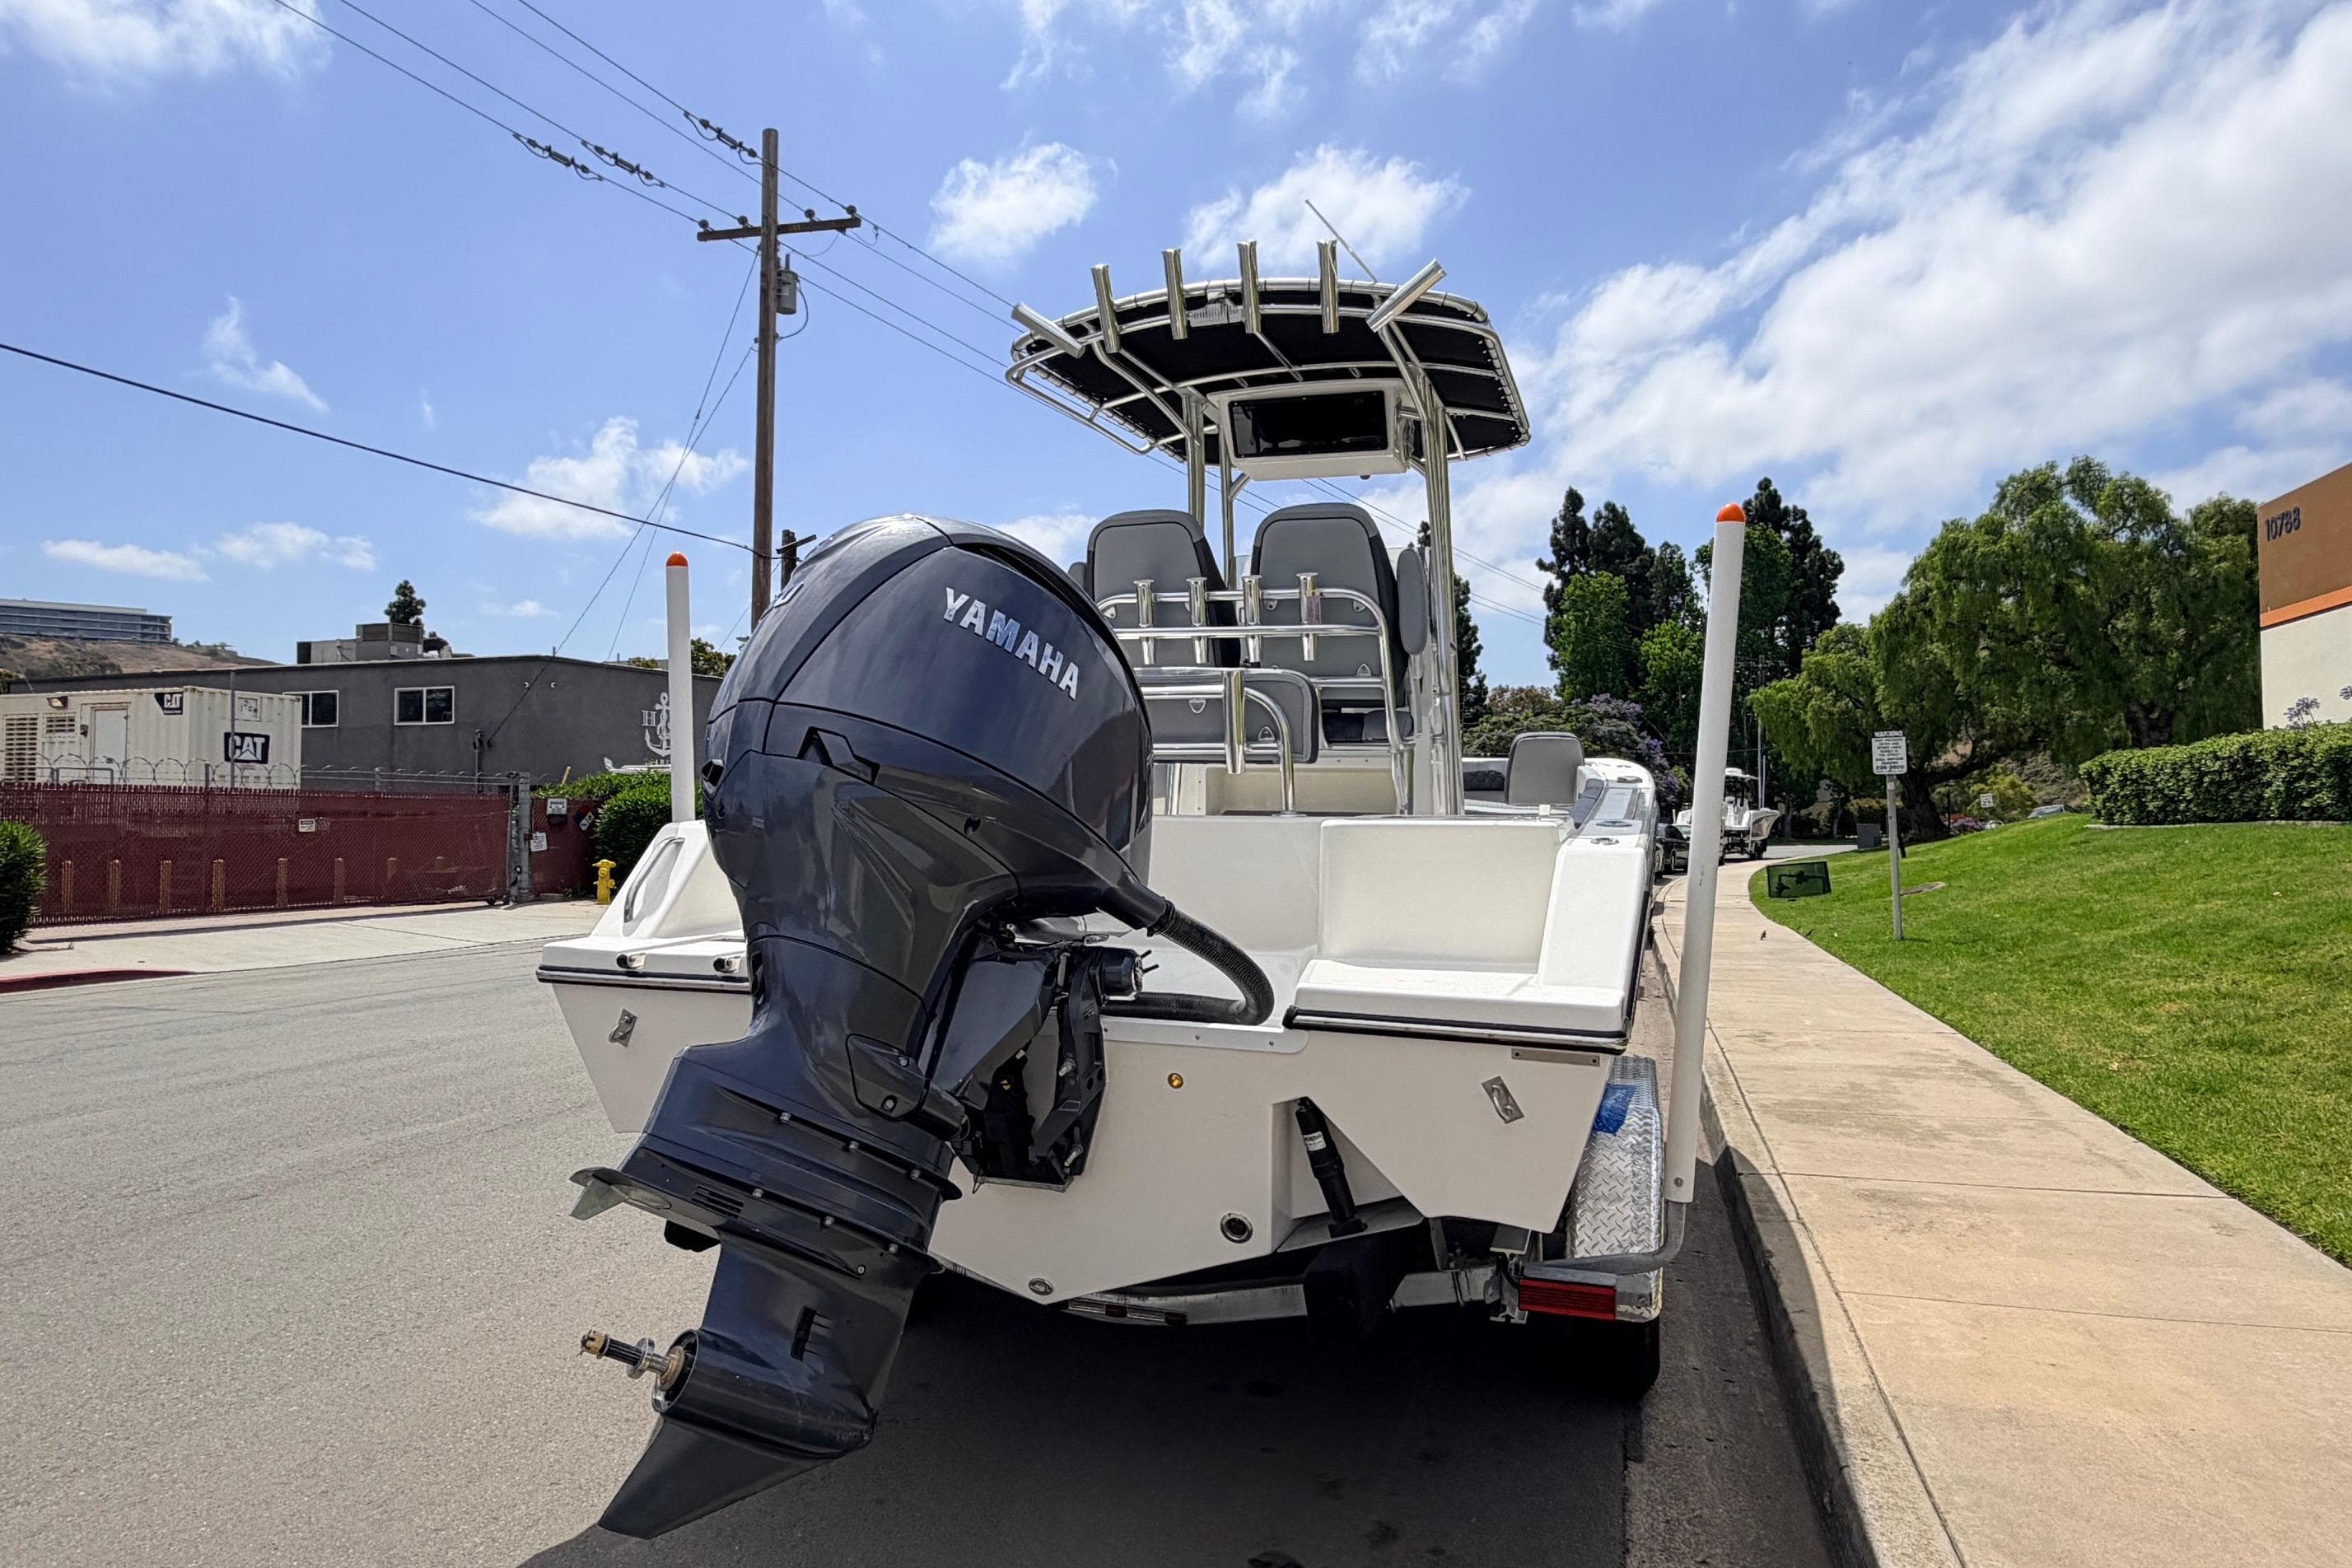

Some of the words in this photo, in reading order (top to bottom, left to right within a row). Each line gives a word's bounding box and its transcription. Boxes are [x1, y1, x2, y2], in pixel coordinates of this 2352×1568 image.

[2266, 506, 2301, 541] 10788
[943, 587, 1079, 700] YAMAHA
[164, 694, 182, 707] CAT
[229, 735, 265, 760] CAT
